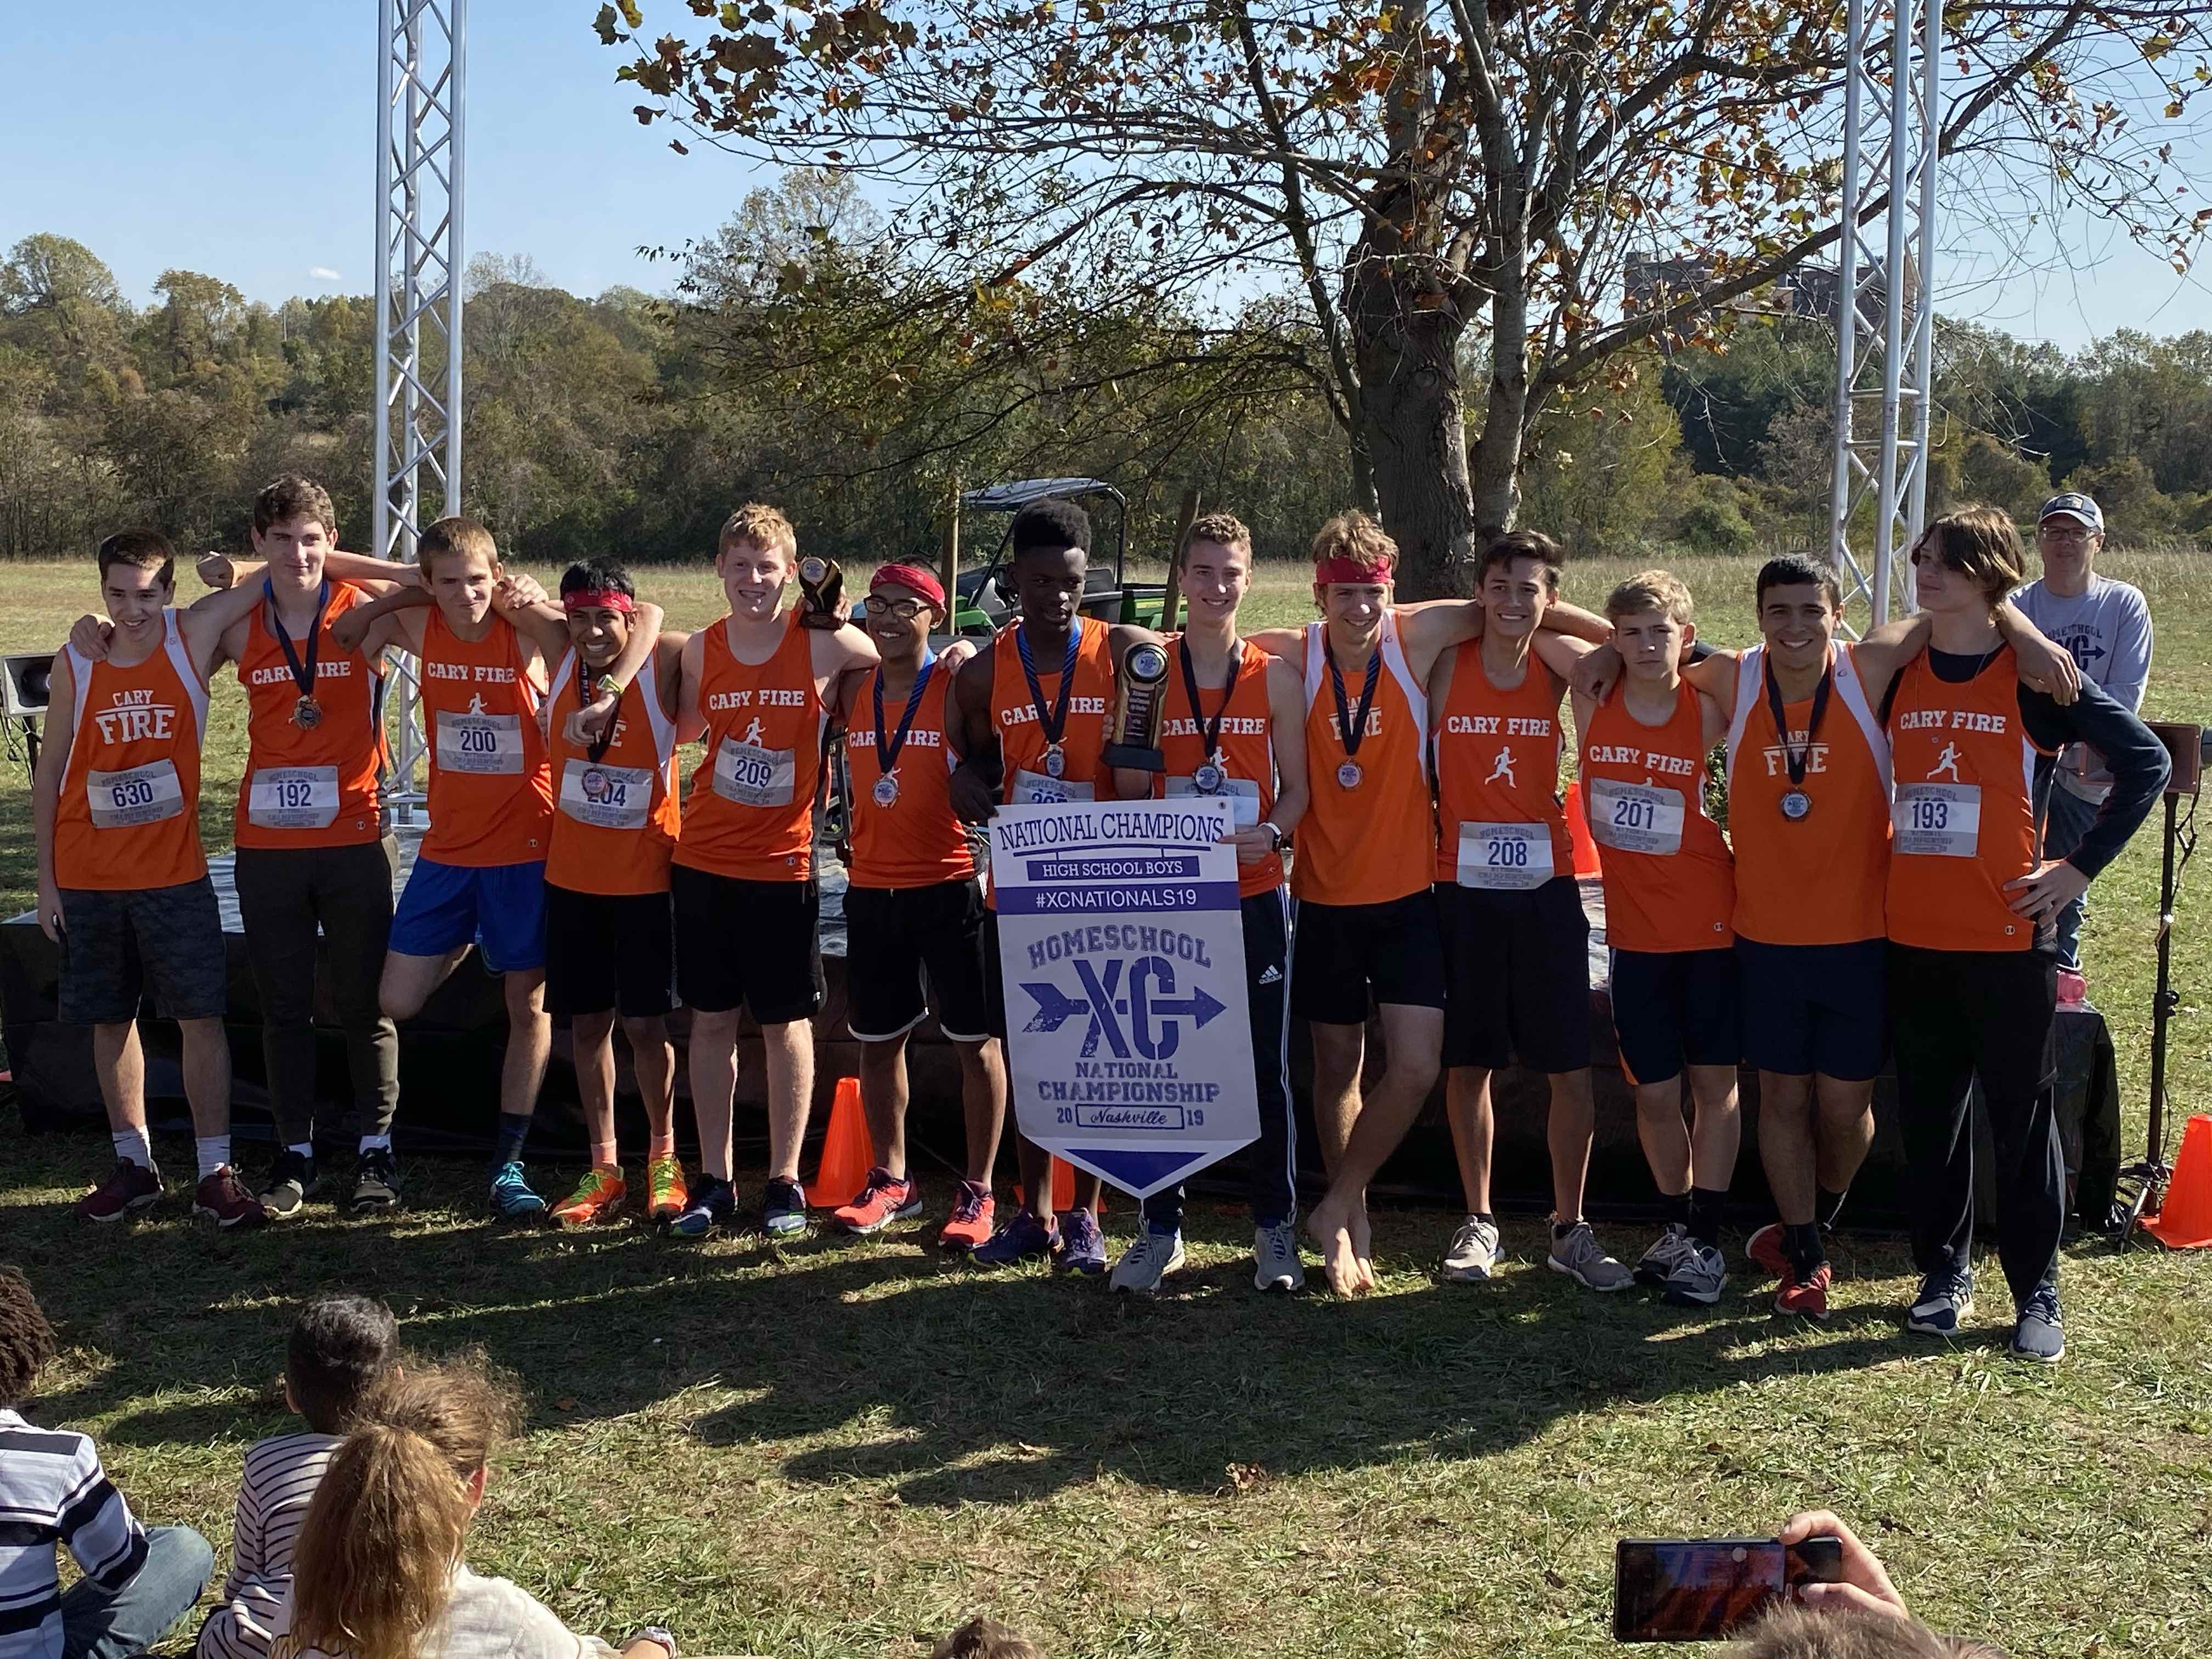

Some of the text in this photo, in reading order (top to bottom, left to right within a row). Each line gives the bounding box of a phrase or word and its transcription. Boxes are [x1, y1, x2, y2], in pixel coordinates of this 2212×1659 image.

[2047, 624, 2102, 639] MESCHOOL
[317, 661, 351, 678] IRE
[427, 662, 516, 683] CARY FIRE
[112, 690, 154, 707] CARY
[709, 690, 804, 710] CARY FIRE
[1070, 697, 1105, 714] IRE
[95, 709, 176, 745] FIRE
[1219, 718, 1265, 735] FIRE
[1448, 715, 1550, 736] CARY FIRE
[1900, 710, 2006, 733] CARY FIRE
[460, 730, 496, 752] 200
[849, 730, 941, 747] CAR IRE
[1779, 730, 1809, 743] ARY
[1589, 746, 1695, 776] CARY FIRE
[735, 759, 771, 787] 209
[112, 782, 154, 807] 630
[276, 784, 312, 808] 192
[588, 784, 625, 806] 04
[1614, 800, 1654, 829] 201
[1912, 802, 1948, 829] 193
[997, 813, 1224, 850] NATIONAL CHAMPIONS
[1488, 841, 1527, 866] 208
[1042, 861, 1183, 877] HIGH SCHOOL BOYS
[1036, 889, 1197, 909] #XCNATIONALS19
[1027, 924, 1211, 970] HOMESCHOOL
[1073, 956, 1179, 1060] XC
[1075, 1062, 1178, 1079] NATIONAL
[1037, 1081, 1221, 1103] CHAMPIONSHIP
[1057, 1107, 1204, 1126] 20 Nashville 19
